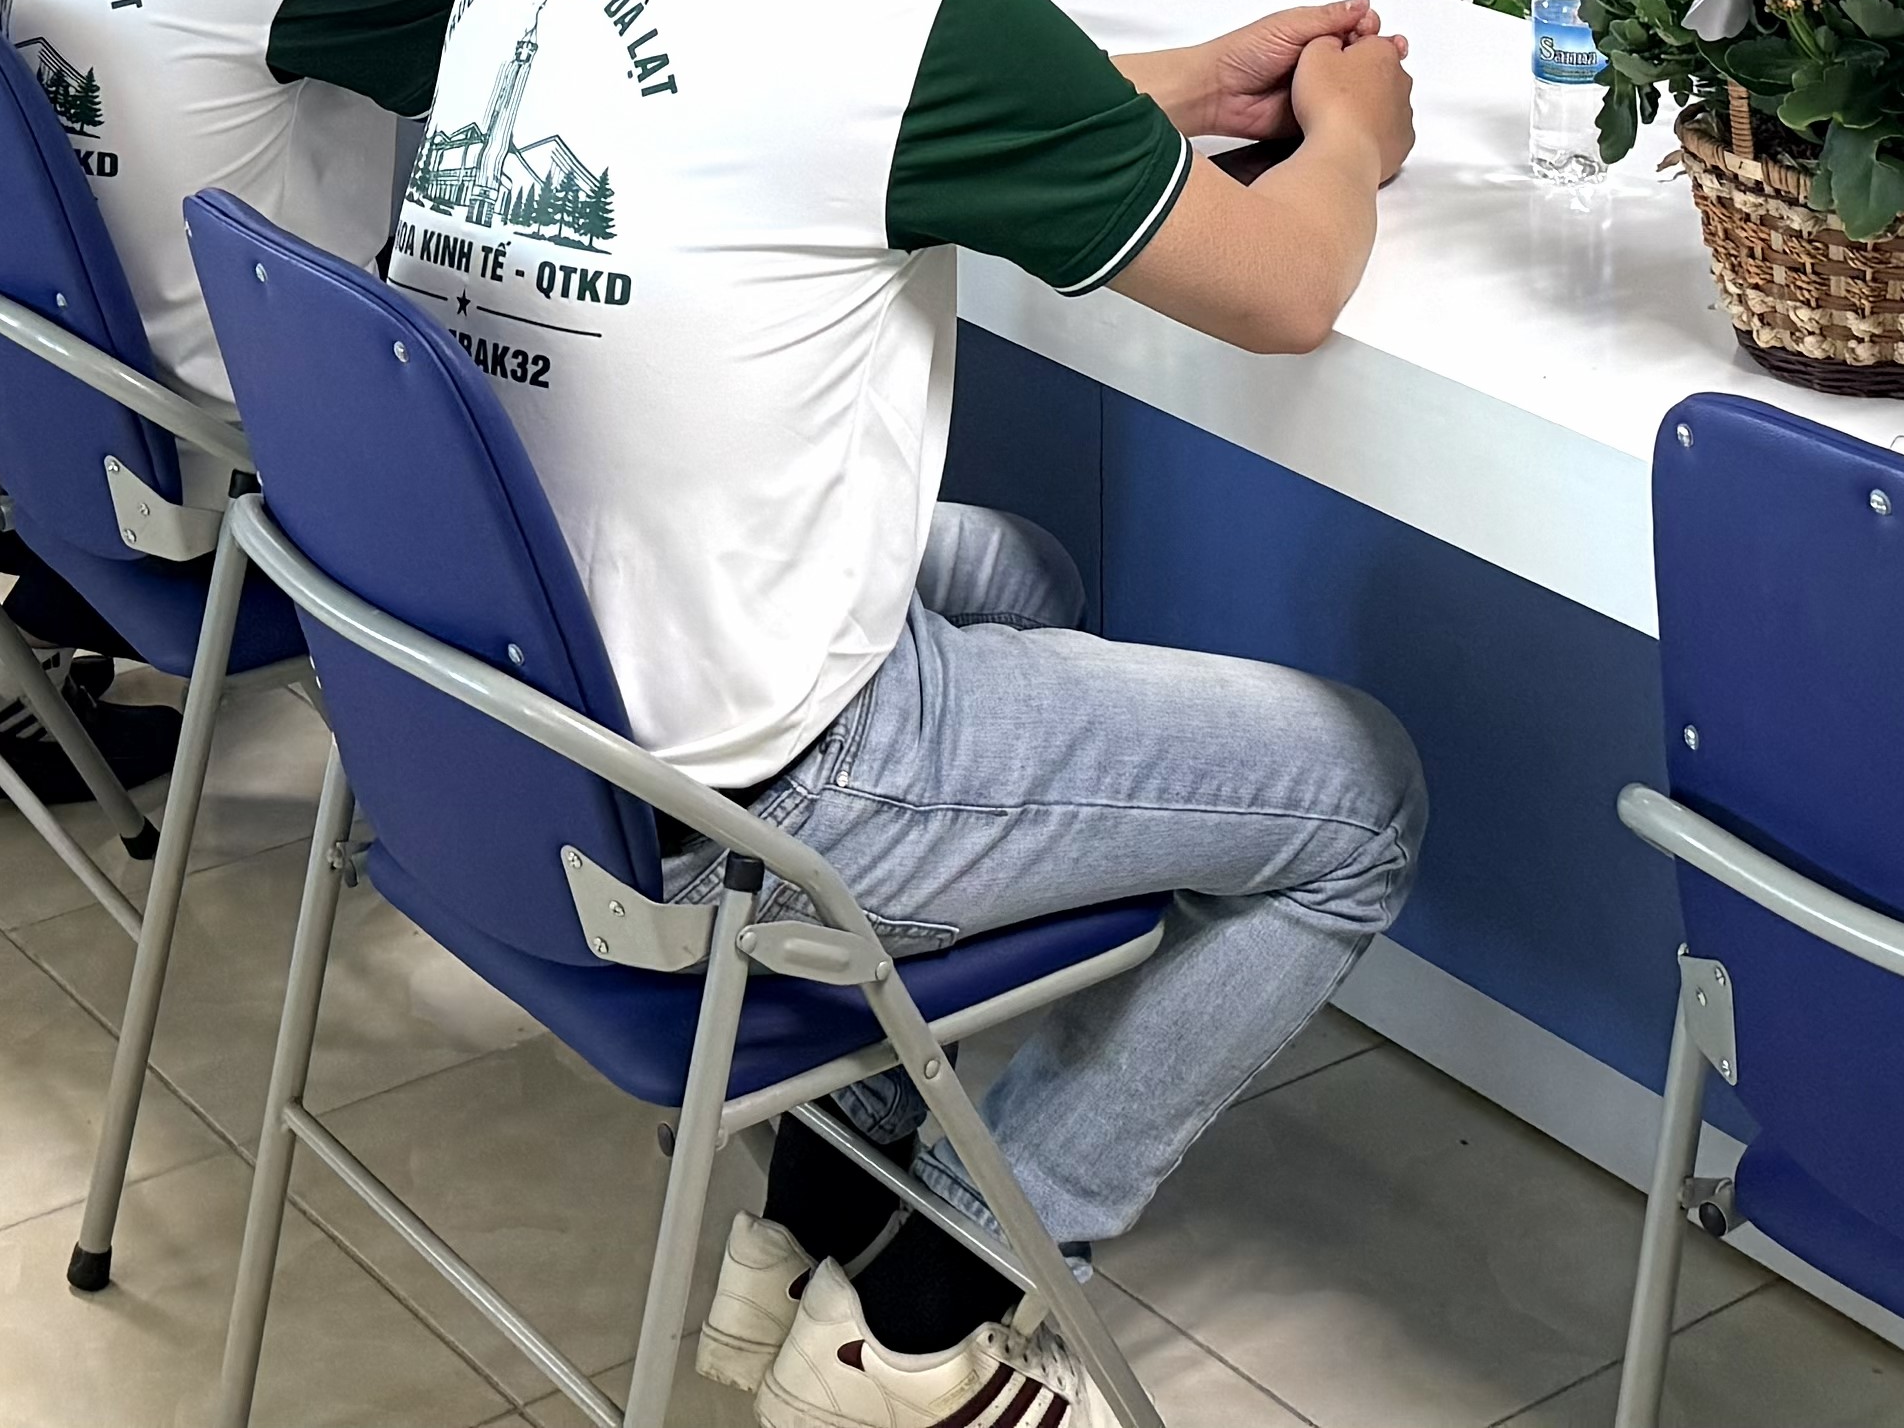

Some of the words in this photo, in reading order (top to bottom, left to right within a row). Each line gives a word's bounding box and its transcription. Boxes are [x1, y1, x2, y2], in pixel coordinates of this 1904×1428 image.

[627, 28, 678, 97] LẠT
[77, 149, 119, 178] KD
[419, 228, 474, 274] KINH
[480, 241, 512, 283] TẾ
[535, 260, 632, 306] QTKD
[448, 328, 551, 390] BAK32
